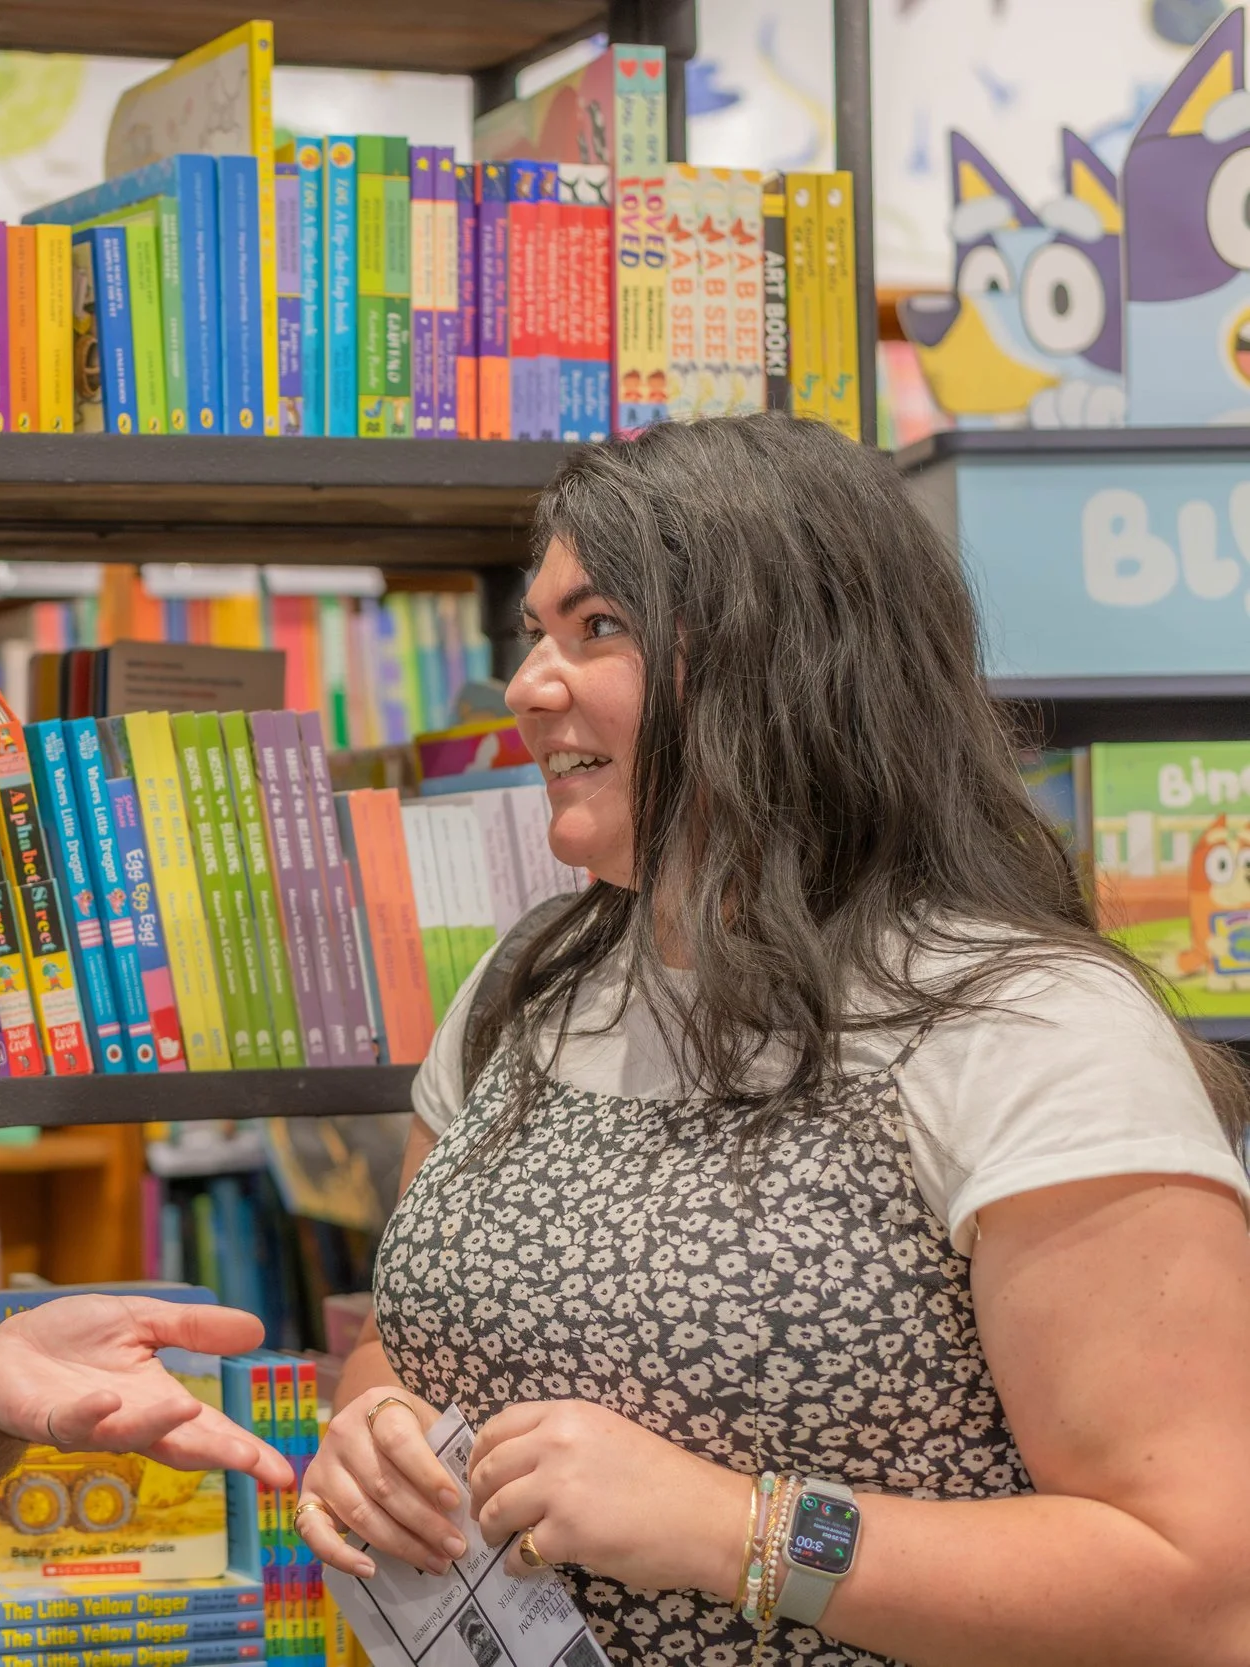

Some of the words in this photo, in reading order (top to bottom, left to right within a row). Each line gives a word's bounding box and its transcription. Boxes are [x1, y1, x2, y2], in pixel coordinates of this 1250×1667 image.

[618, 177, 641, 268] LOVED
[642, 177, 666, 269] LOVED
[672, 252, 692, 270] A
[765, 250, 785, 298] ART
[672, 279, 692, 295] B
[334, 302, 349, 335] book
[671, 305, 694, 359] SEE
[765, 303, 787, 377] BOOK!
[61, 808, 73, 837] Little
[67, 839, 86, 884] Dragon?
[9, 789, 41, 888] Alphabet
[31, 886, 57, 953] Street
[126, 848, 143, 880] Egg
[262, 748, 277, 779] BABIES
[274, 818, 292, 868] BILLABONG
[300, 966, 311, 991] James
[131, 880, 150, 912] Egg
[137, 913, 159, 948] Egg!
[11, 1547, 46, 1559] Betty
[51, 1546, 75, 1557] and
[78, 1545, 108, 1556] Alan
[110, 1543, 176, 1554] Gilderdale
[795, 1535, 825, 1553] 3:00
[467, 1551, 489, 1574] Wang
[1, 1601, 34, 1621] The
[37, 1599, 79, 1619] Little
[82, 1596, 134, 1616] Yellow
[136, 1592, 189, 1617] Digger
[441, 1585, 462, 1610] Cassy
[497, 1575, 528, 1609] HOPPER
[519, 1577, 566, 1636] BOOKROOM
